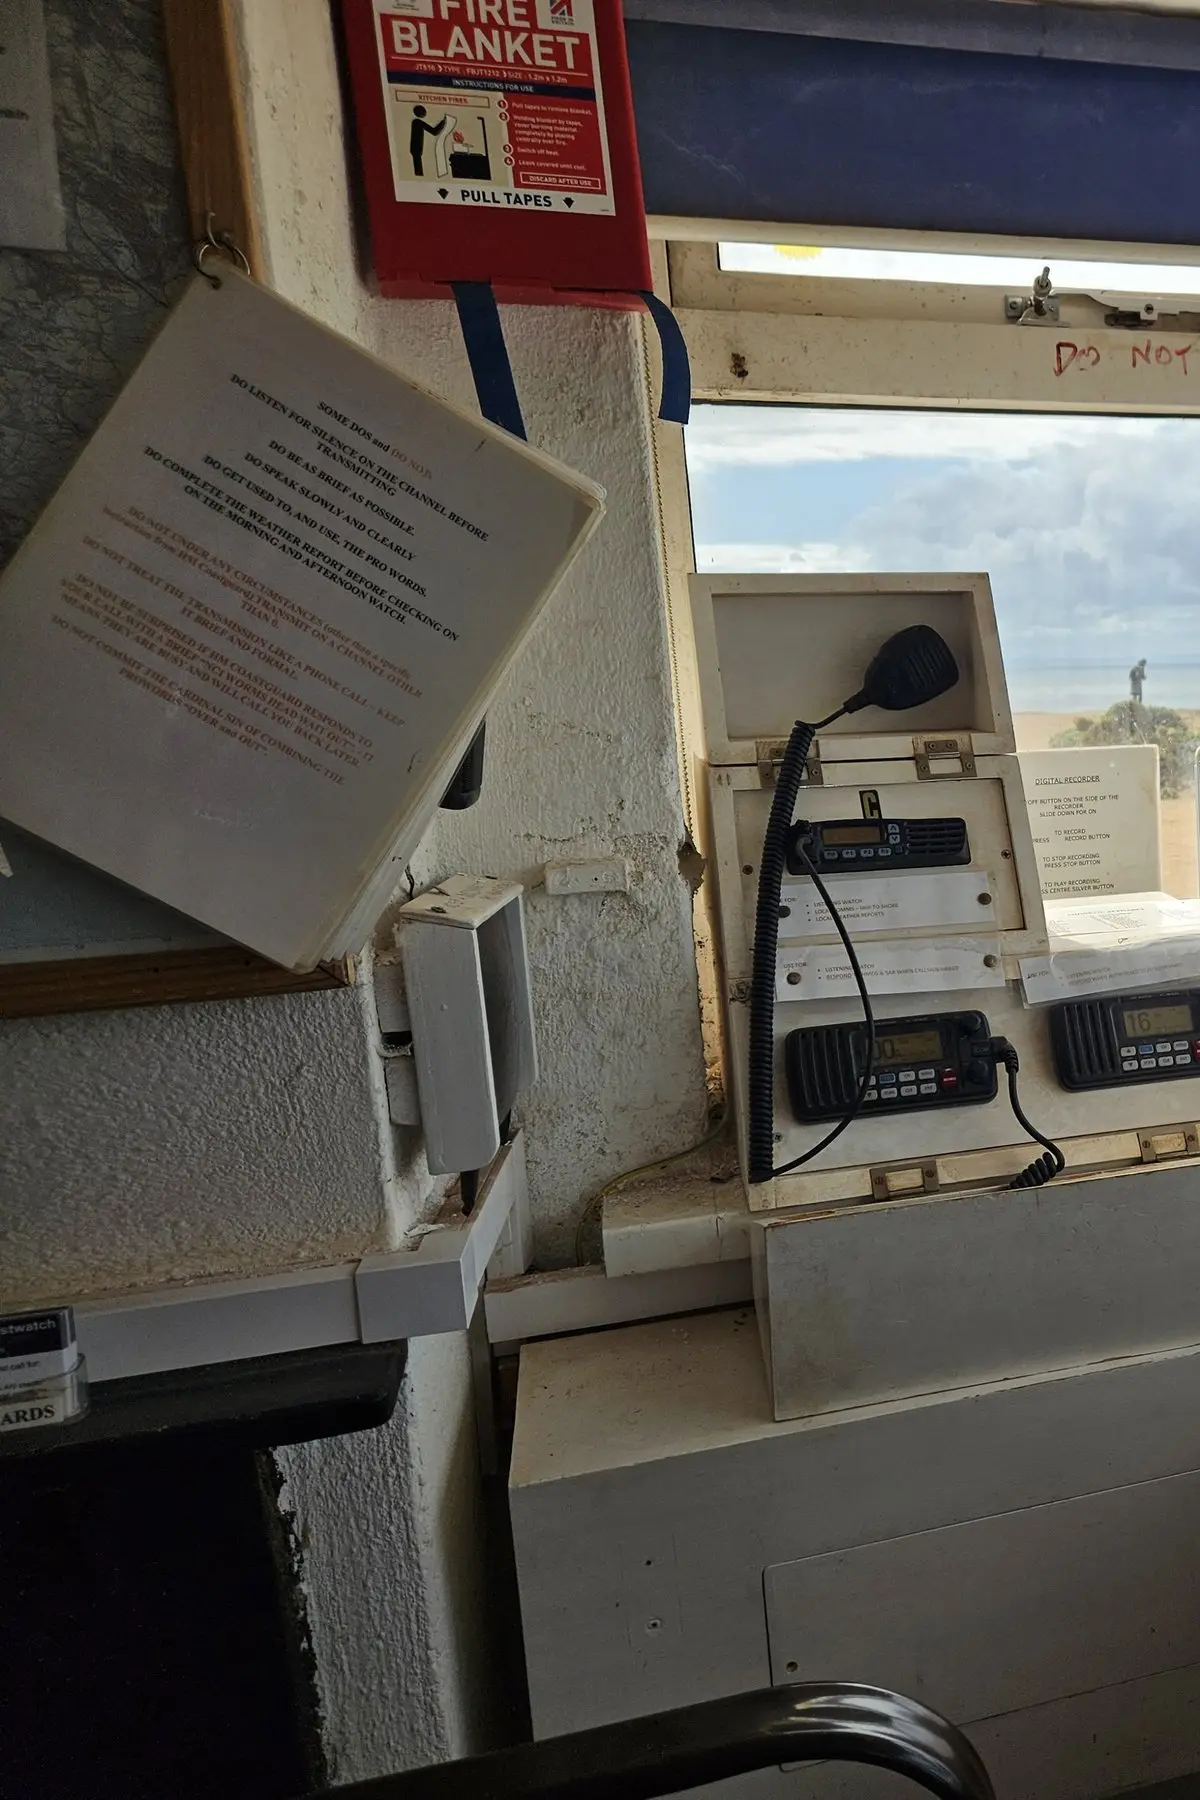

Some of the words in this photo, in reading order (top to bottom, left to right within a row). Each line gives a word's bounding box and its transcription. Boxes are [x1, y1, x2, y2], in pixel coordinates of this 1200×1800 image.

[436, 0, 531, 28] FIRE
[392, 19, 580, 69] BLANKET
[418, 95, 447, 103] KITCHEN
[449, 96, 468, 104] FIRES
[452, 79, 504, 91] INSTRUCTIONS
[505, 84, 518, 92] FOR
[461, 189, 501, 205] PULL
[503, 192, 553, 207] TAPES
[529, 175, 557, 184] DISCARD
[558, 177, 578, 186] AFTER
[579, 179, 592, 187] USE
[1053, 341, 1101, 377] DO
[1131, 339, 1192, 376] NOT
[317, 401, 349, 426] SOME
[350, 422, 372, 440] DOS
[372, 436, 390, 452] and
[230, 374, 248, 389] DO
[249, 385, 287, 414] LISTEN
[288, 411, 311, 429] FOR
[311, 425, 359, 459] SILENCE
[358, 455, 374, 469] ON
[376, 466, 397, 483] THE
[398, 480, 449, 516] CHANNEL
[448, 512, 488, 541] BEFORE
[316, 442, 396, 496] TRANSMITTING
[269, 440, 286, 455] DO
[286, 451, 301, 464] BE
[302, 461, 317, 474] AS
[317, 470, 350, 495] BRIEF
[349, 490, 364, 503] AS
[364, 500, 415, 535] POSSIBLE.
[203, 455, 221, 470] DO
[222, 466, 245, 485] GET
[246, 481, 274, 502] USED
[294, 510, 317, 528] AND
[342, 540, 364, 557] THE
[365, 554, 387, 571] PRO
[387, 568, 428, 596] WORDS.
[245, 453, 261, 467] DO
[262, 464, 298, 489] SPEAK
[298, 486, 345, 518] SLOWLY
[344, 514, 366, 531] AND
[367, 528, 415, 561] CLEARLY
[143, 446, 162, 462] DO
[162, 457, 225, 500] COMPLETE
[225, 495, 247, 513] THE
[248, 509, 301, 546] WEATHER
[302, 542, 343, 572] REPORT
[345, 569, 386, 597] BEFORE
[387, 594, 441, 630] CHECKING
[442, 628, 458, 641] ON
[183, 485, 201, 500] ON
[201, 496, 224, 514] THE
[226, 510, 278, 546] MORNING
[279, 543, 302, 560] AND
[303, 557, 367, 599] AFTERNOON
[367, 596, 407, 623] WATCH.
[310, 629, 327, 643] ON
[328, 639, 337, 648] A
[294, 659, 303, 668] A
[862, 792, 879, 819] C
[1127, 1012, 1152, 1032] 16
